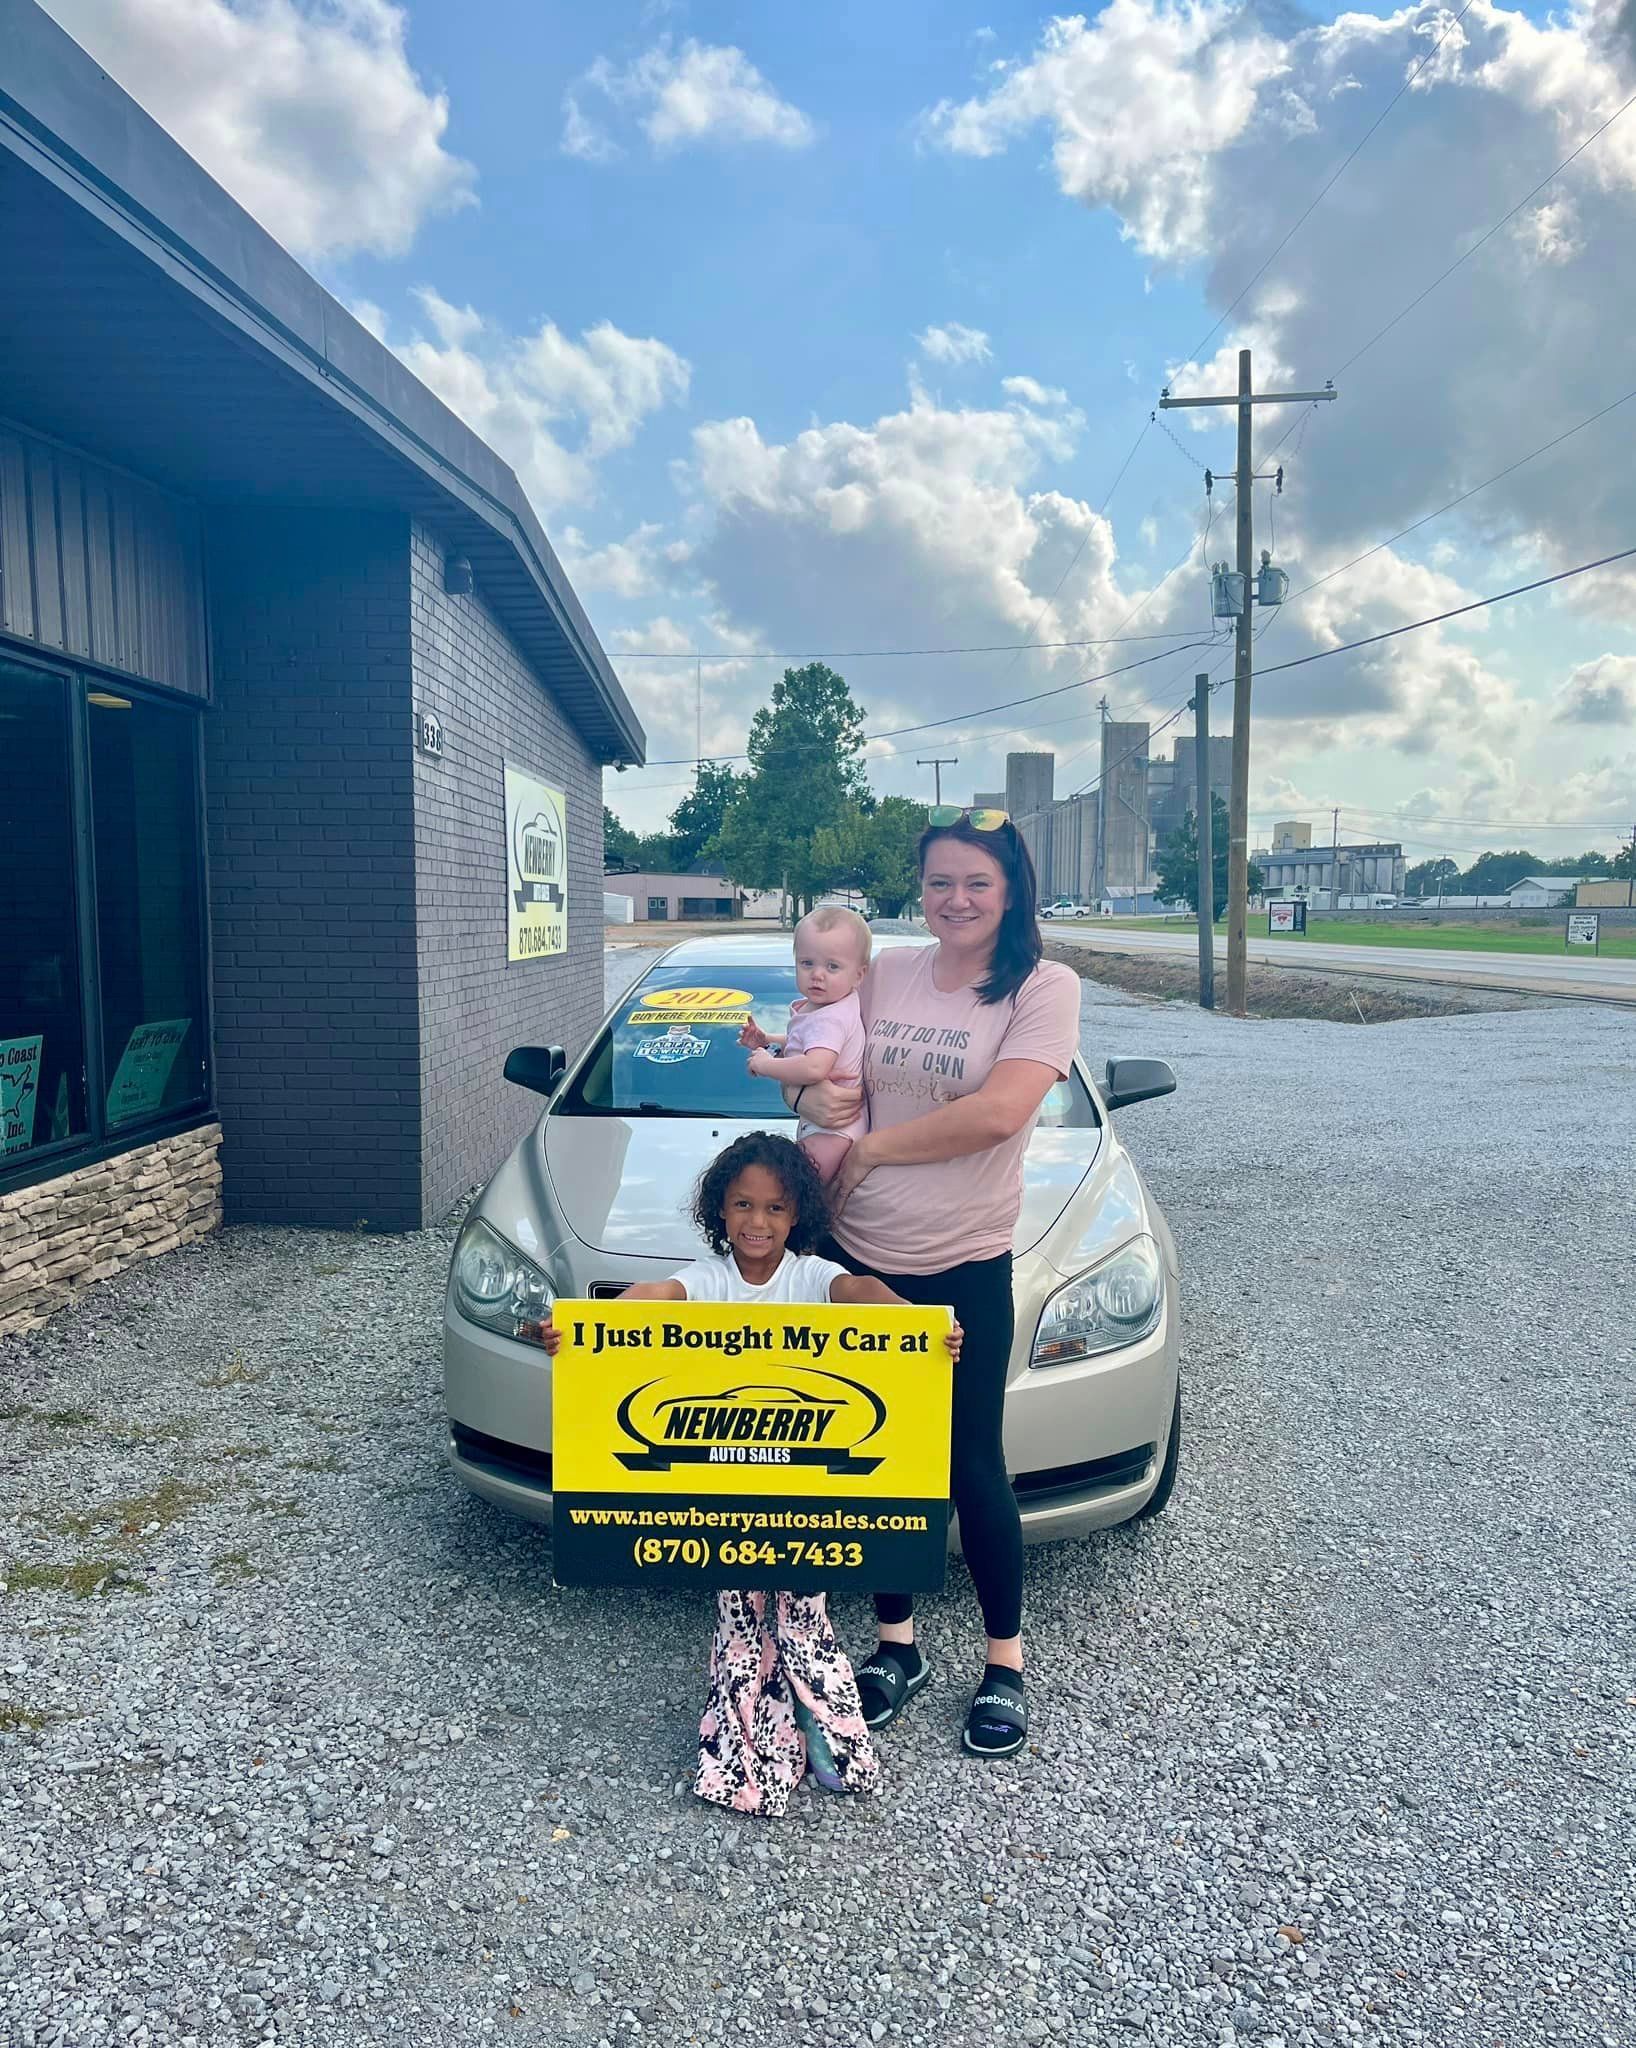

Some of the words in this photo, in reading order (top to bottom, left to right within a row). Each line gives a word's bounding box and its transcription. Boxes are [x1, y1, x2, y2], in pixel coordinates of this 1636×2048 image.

[424, 723, 441, 751] 338
[524, 833, 556, 877] NEWBERRY
[659, 992, 734, 1004] 2011
[631, 1013, 654, 1021] BUY
[655, 1012, 685, 1020] HERE
[694, 1012, 715, 1020] PAY
[717, 1012, 746, 1020] HERE
[874, 1020, 915, 1041] CAN'T
[912, 1027, 936, 1044] DO
[937, 1029, 970, 1050] THIS
[7, 1046, 37, 1065] Coast
[882, 1046, 912, 1066] MY
[922, 1052, 965, 1080] OWN
[7, 1121, 26, 1139] Inc.
[573, 1322, 585, 1346] I
[593, 1323, 652, 1353] Just
[662, 1324, 773, 1355] Bought
[783, 1326, 830, 1357] My
[839, 1327, 891, 1352] Car
[900, 1331, 929, 1353] at
[663, 1406, 836, 1442] NEWBERRY
[709, 1447, 746, 1463] AUTO
[749, 1448, 791, 1464] SALES
[569, 1506, 928, 1533] www.newberryautosales.com
[633, 1537, 710, 1568] (870)
[719, 1540, 863, 1567] 684-7433
[974, 1694, 1014, 1709] Reebok
